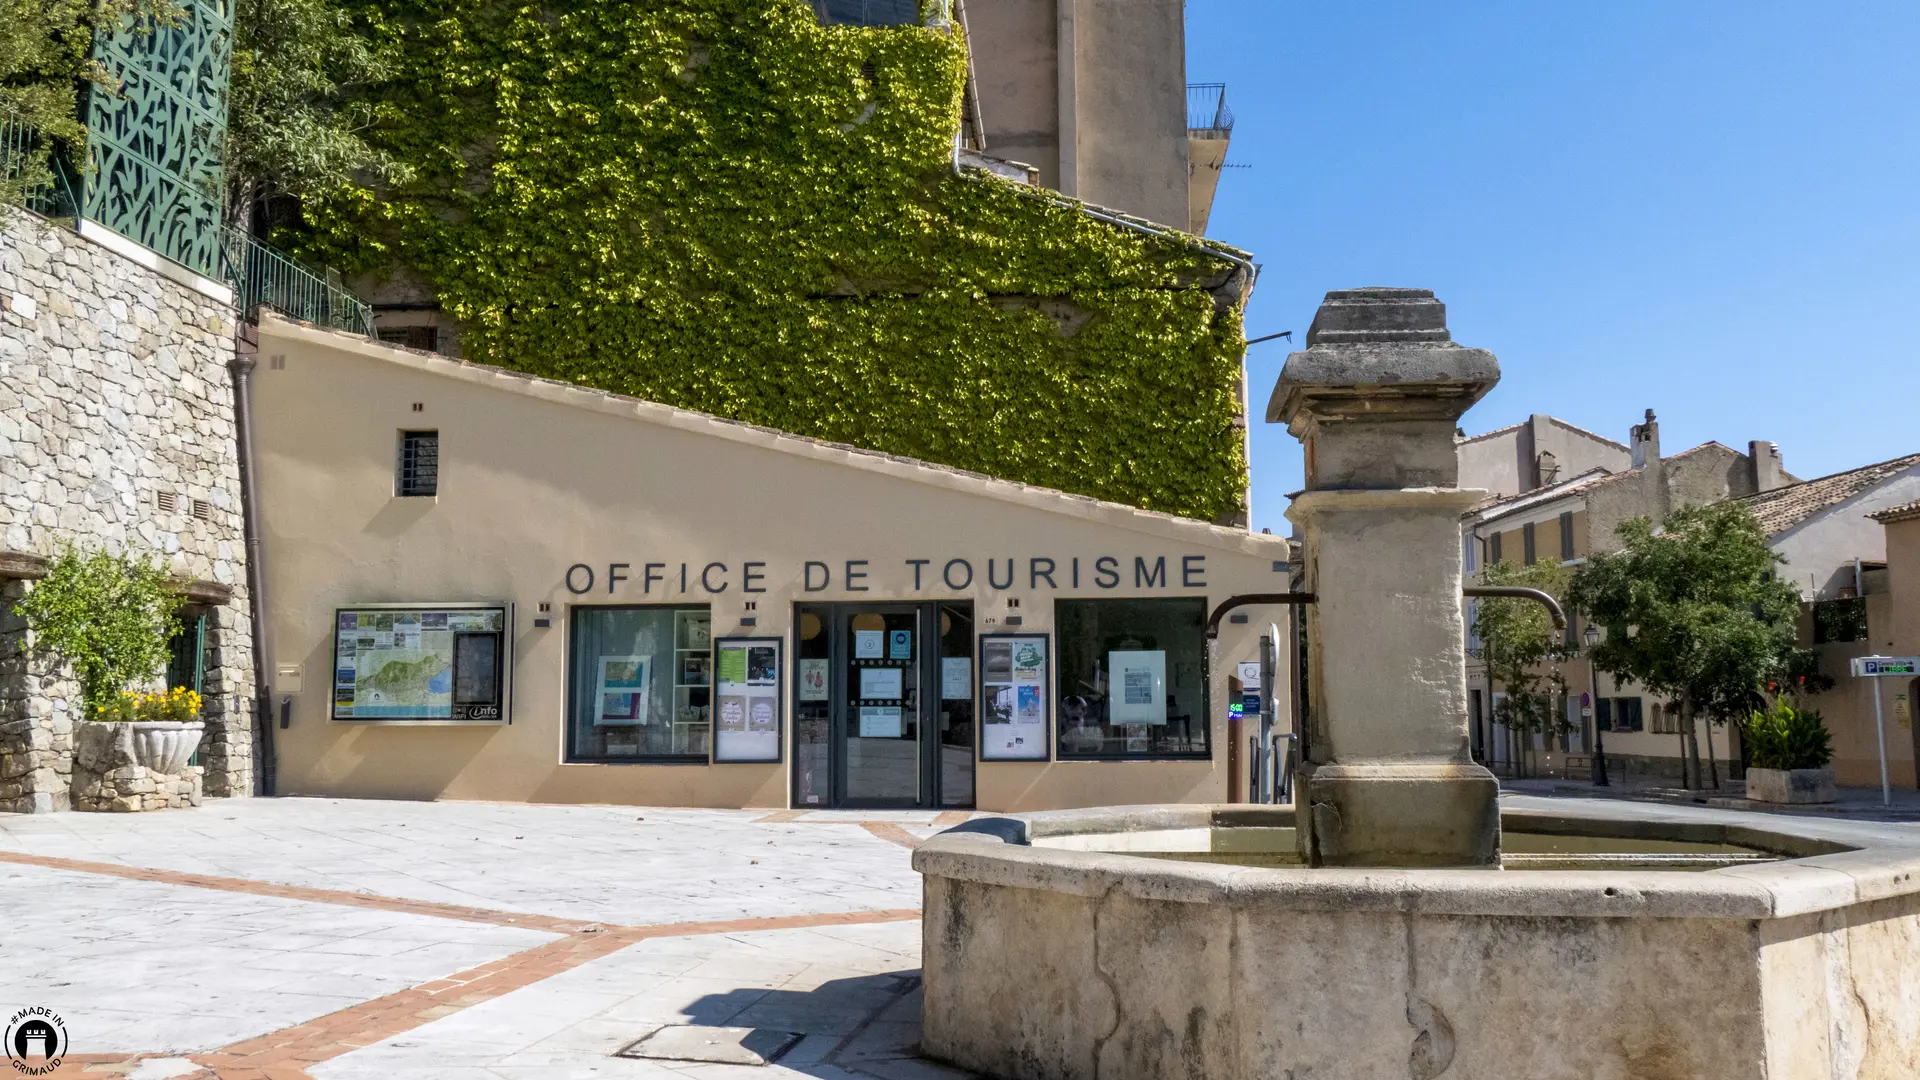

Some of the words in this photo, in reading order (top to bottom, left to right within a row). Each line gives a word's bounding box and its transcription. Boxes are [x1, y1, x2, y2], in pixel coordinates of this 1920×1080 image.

[565, 562, 767, 594] OFFICE
[804, 560, 869, 592] DE
[905, 556, 1207, 591] TOURISME
